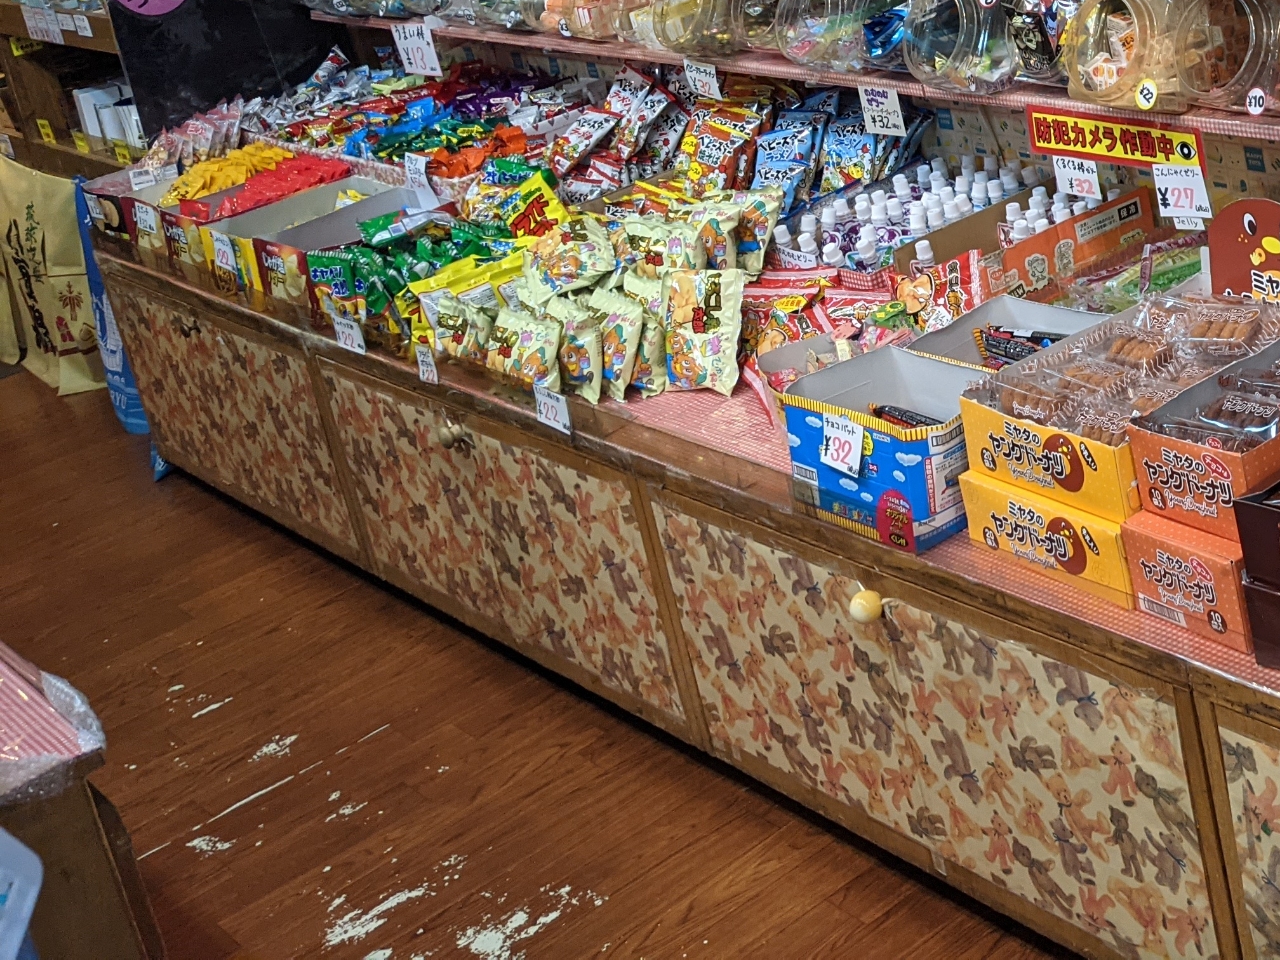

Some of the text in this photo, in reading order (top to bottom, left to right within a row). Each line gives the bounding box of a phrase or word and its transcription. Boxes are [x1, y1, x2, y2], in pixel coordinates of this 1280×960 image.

[1248, 94, 1265, 109] ¥10
[871, 113, 891, 130] ¥32
[1034, 117, 1175, 161] 防犯カメラ作動中
[1068, 177, 1095, 195] ¥32
[1157, 186, 1195, 209] ¥27
[1176, 217, 1199, 229] Jelly
[1004, 421, 1041, 445] ミヤタの
[824, 434, 853, 466] ¥32
[988, 433, 1066, 479] ヤングドーナツ
[1162, 449, 1204, 474] ミヤタの
[1144, 458, 1234, 507] ヤングドーナツ
[1008, 501, 1044, 527] ミヤタの
[991, 511, 1069, 560] ヤングドーナツ
[1157, 550, 1192, 574] ミヤタの
[1140, 559, 1217, 606] ヤングドーナツ
